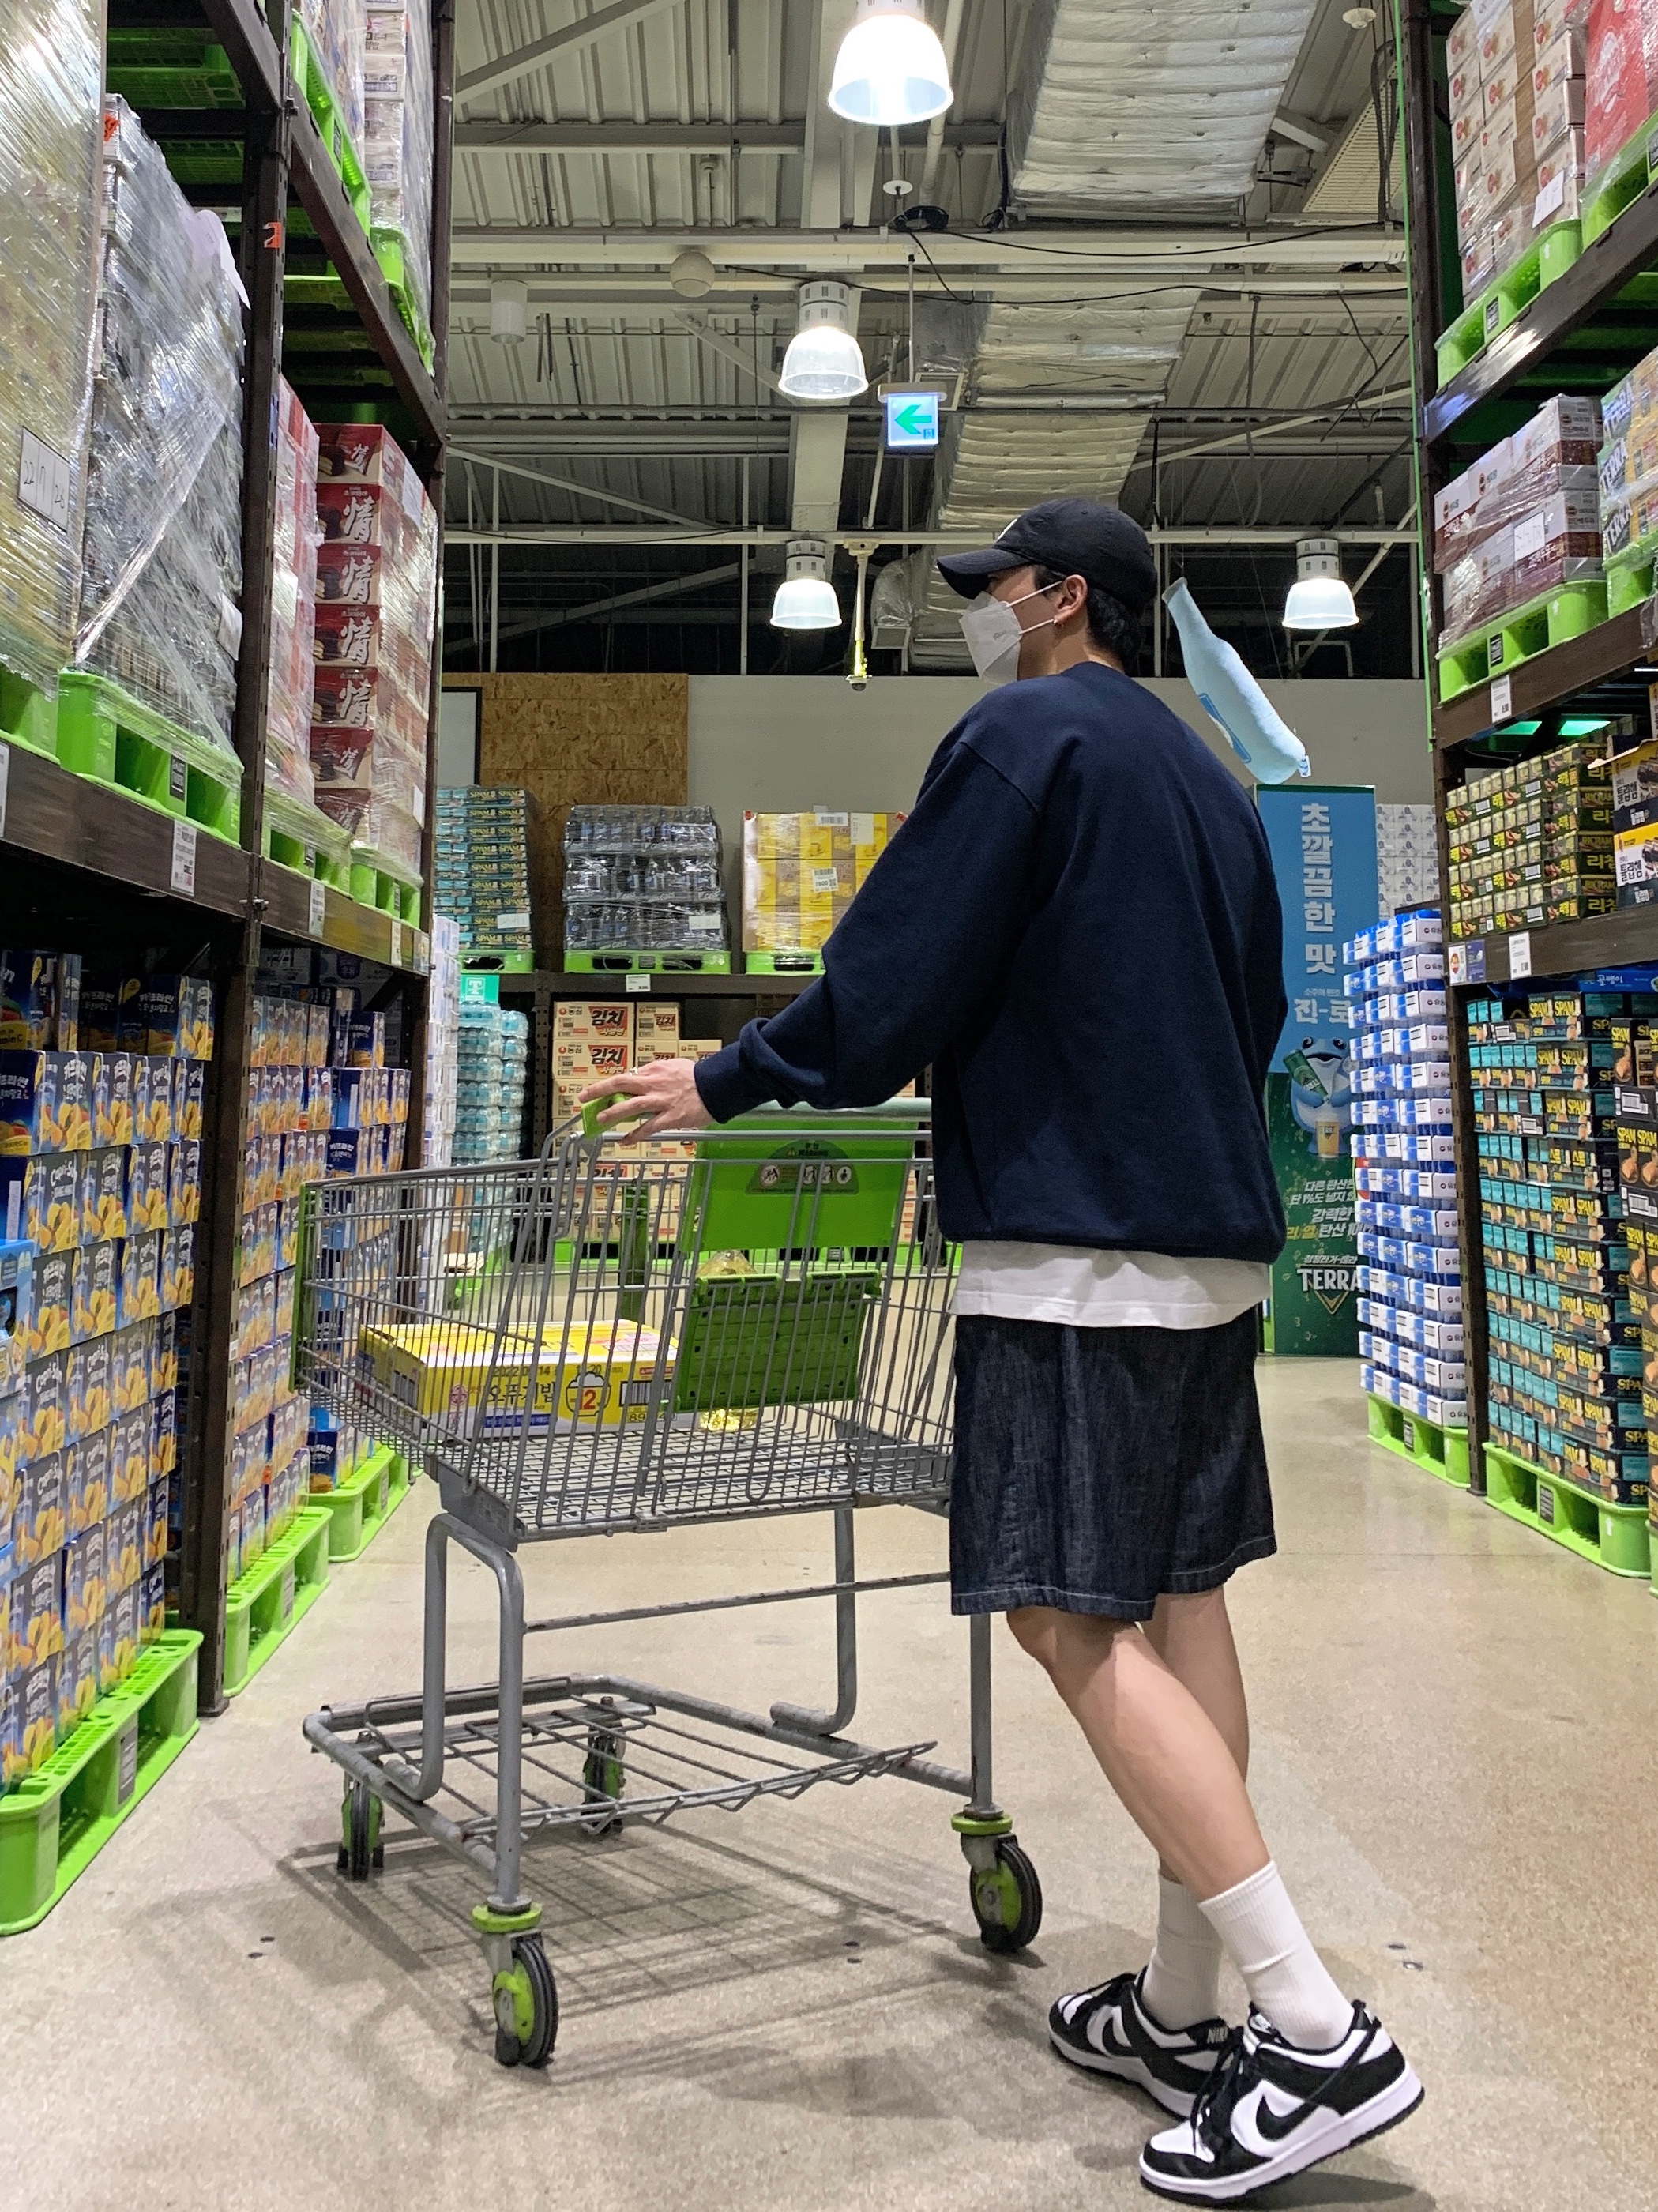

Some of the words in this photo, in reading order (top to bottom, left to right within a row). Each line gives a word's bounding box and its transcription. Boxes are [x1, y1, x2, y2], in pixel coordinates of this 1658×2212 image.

[1600, 438, 1627, 495] TERRA
[1605, 502, 1633, 552] TERRA
[1302, 803, 1335, 933] 초깔끔한
[1306, 943, 1337, 974] 맛
[469, 980, 483, 995] T
[591, 1007, 624, 1026] 김치
[656, 1015, 675, 1025] 김치
[1612, 1027, 1630, 1043] SPAM
[591, 1047, 624, 1065] 김치
[1599, 1070, 1615, 1082] SP
[1602, 1119, 1617, 1130] SP
[1618, 1127, 1636, 1144] SPAM
[1637, 1130, 1657, 1149] SPAM
[1312, 1206, 1354, 1223] 강력한
[1318, 1222, 1347, 1238] 탄산
[1617, 1379, 1643, 1391] SPA
[579, 1389, 596, 1410] 2
[1625, 1431, 1649, 1443] SPA
[1630, 1484, 1649, 1497] SP
